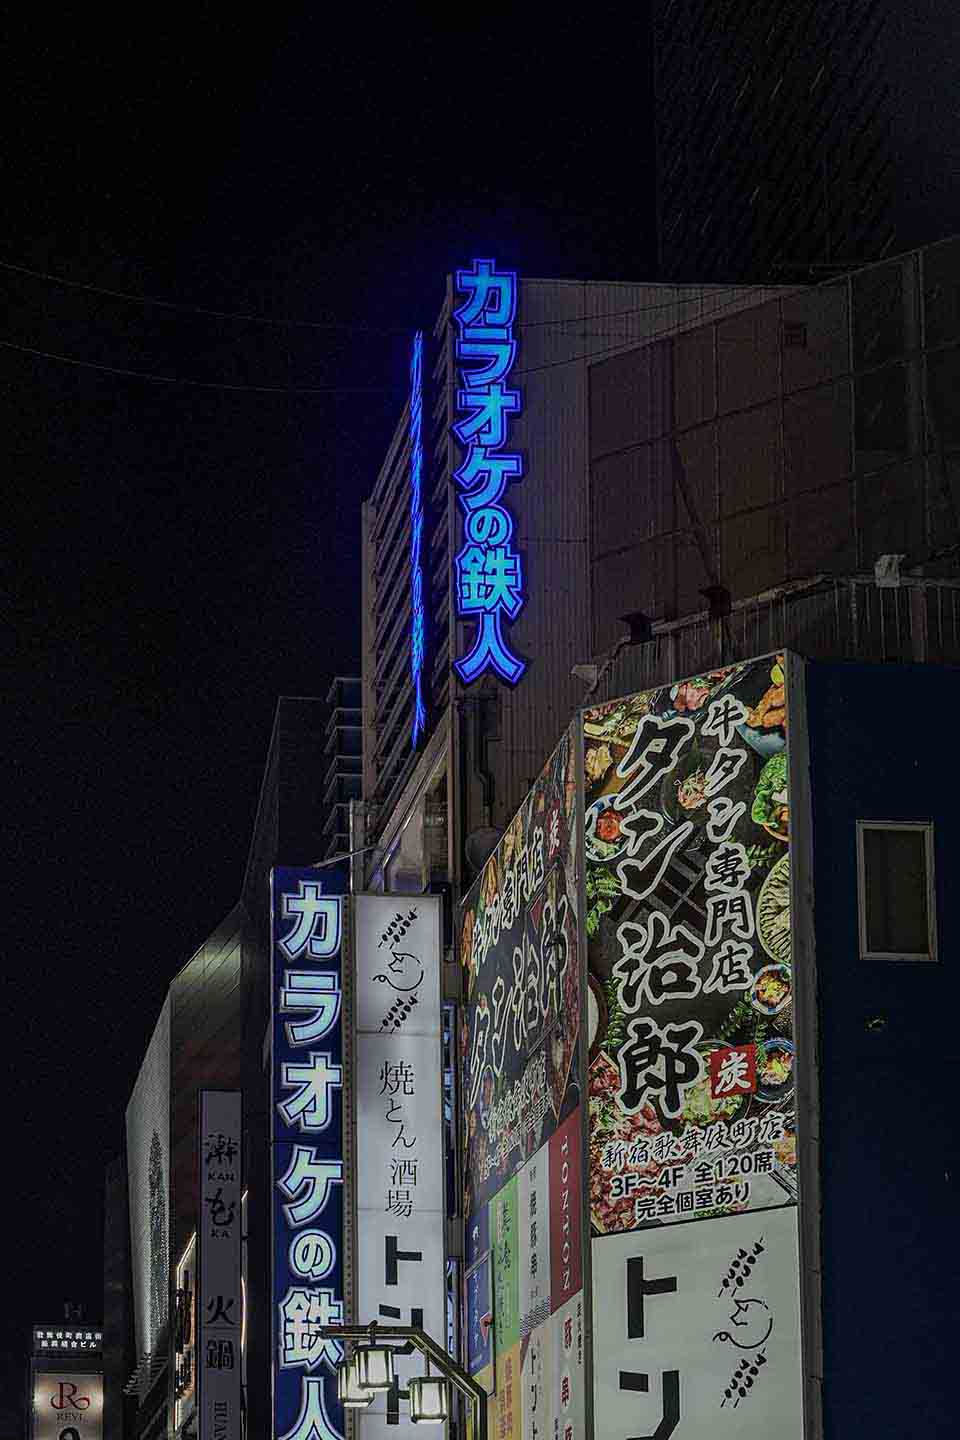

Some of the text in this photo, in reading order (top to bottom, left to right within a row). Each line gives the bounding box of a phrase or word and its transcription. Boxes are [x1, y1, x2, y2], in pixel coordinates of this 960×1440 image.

[452, 258, 526, 686] カラオケの鉄人
[700, 694, 756, 994] 牛タン専門店
[714, 1049, 753, 1096] 炭
[601, 1113, 785, 1171] 新宿歌舞伎町店
[693, 1149, 775, 1184] 全120席
[637, 1182, 751, 1220] 完全個室あり
[207, 1296, 235, 1369] 火鍋
